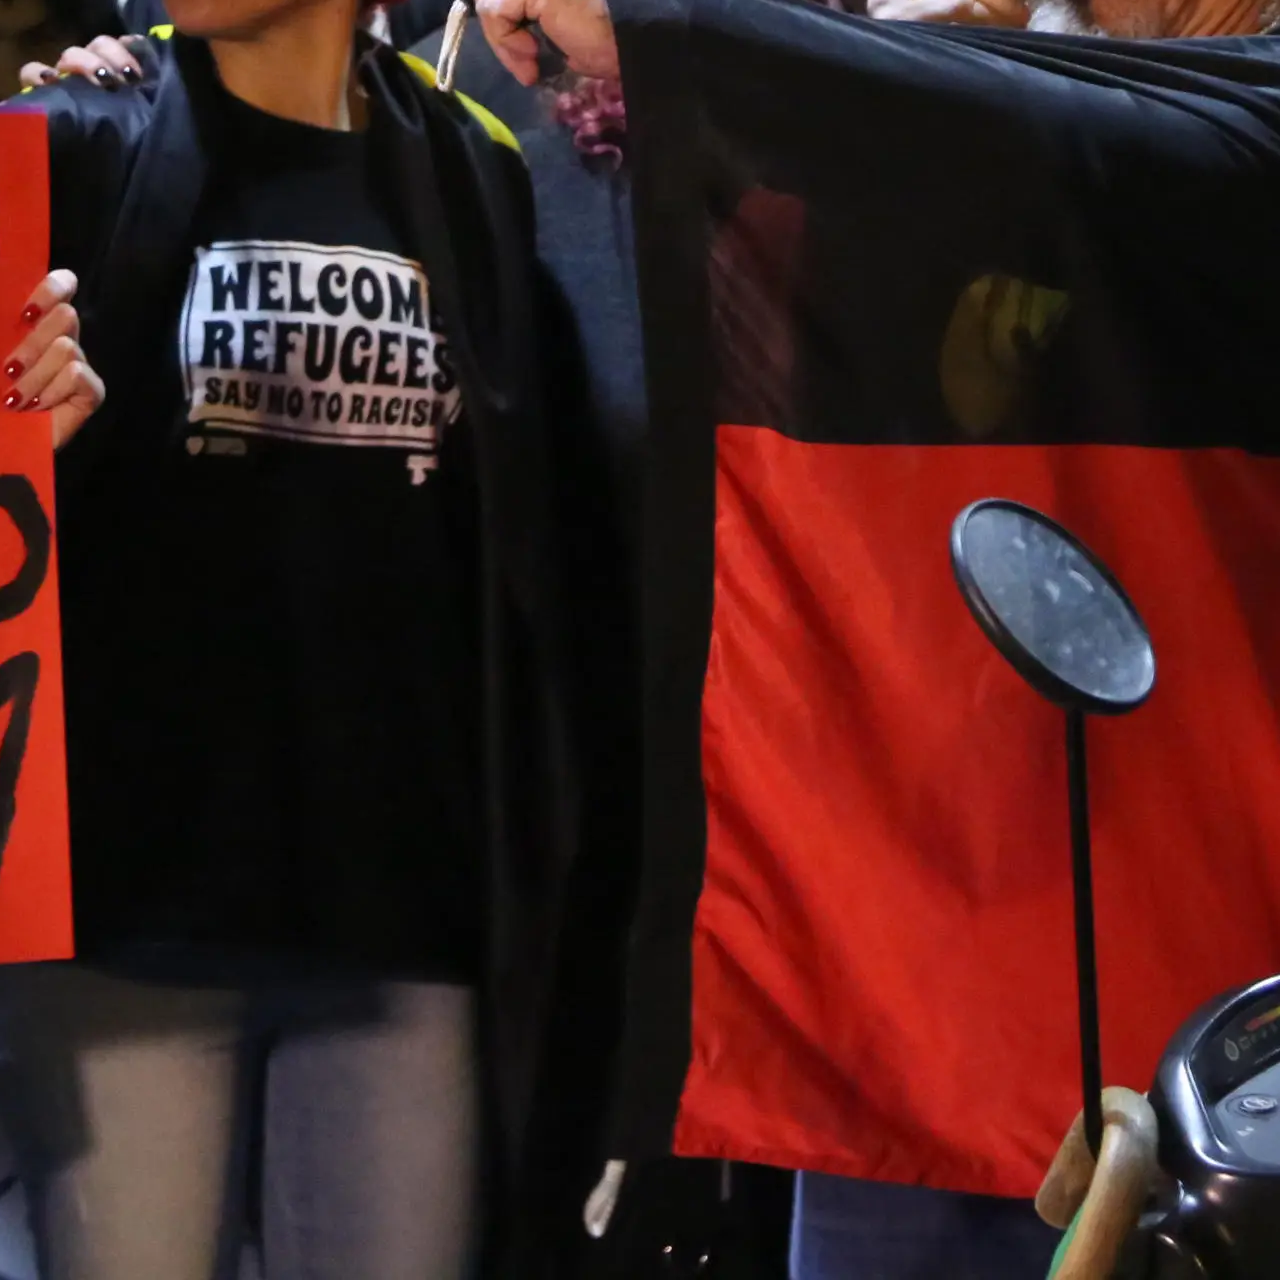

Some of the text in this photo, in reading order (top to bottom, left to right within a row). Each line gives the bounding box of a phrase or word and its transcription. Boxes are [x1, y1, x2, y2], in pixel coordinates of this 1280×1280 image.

[209, 261, 426, 329] WELCOM
[200, 320, 456, 394] REFUGEES
[204, 377, 263, 410] SAY
[266, 384, 304, 419] NO
[311, 390, 343, 423] TO
